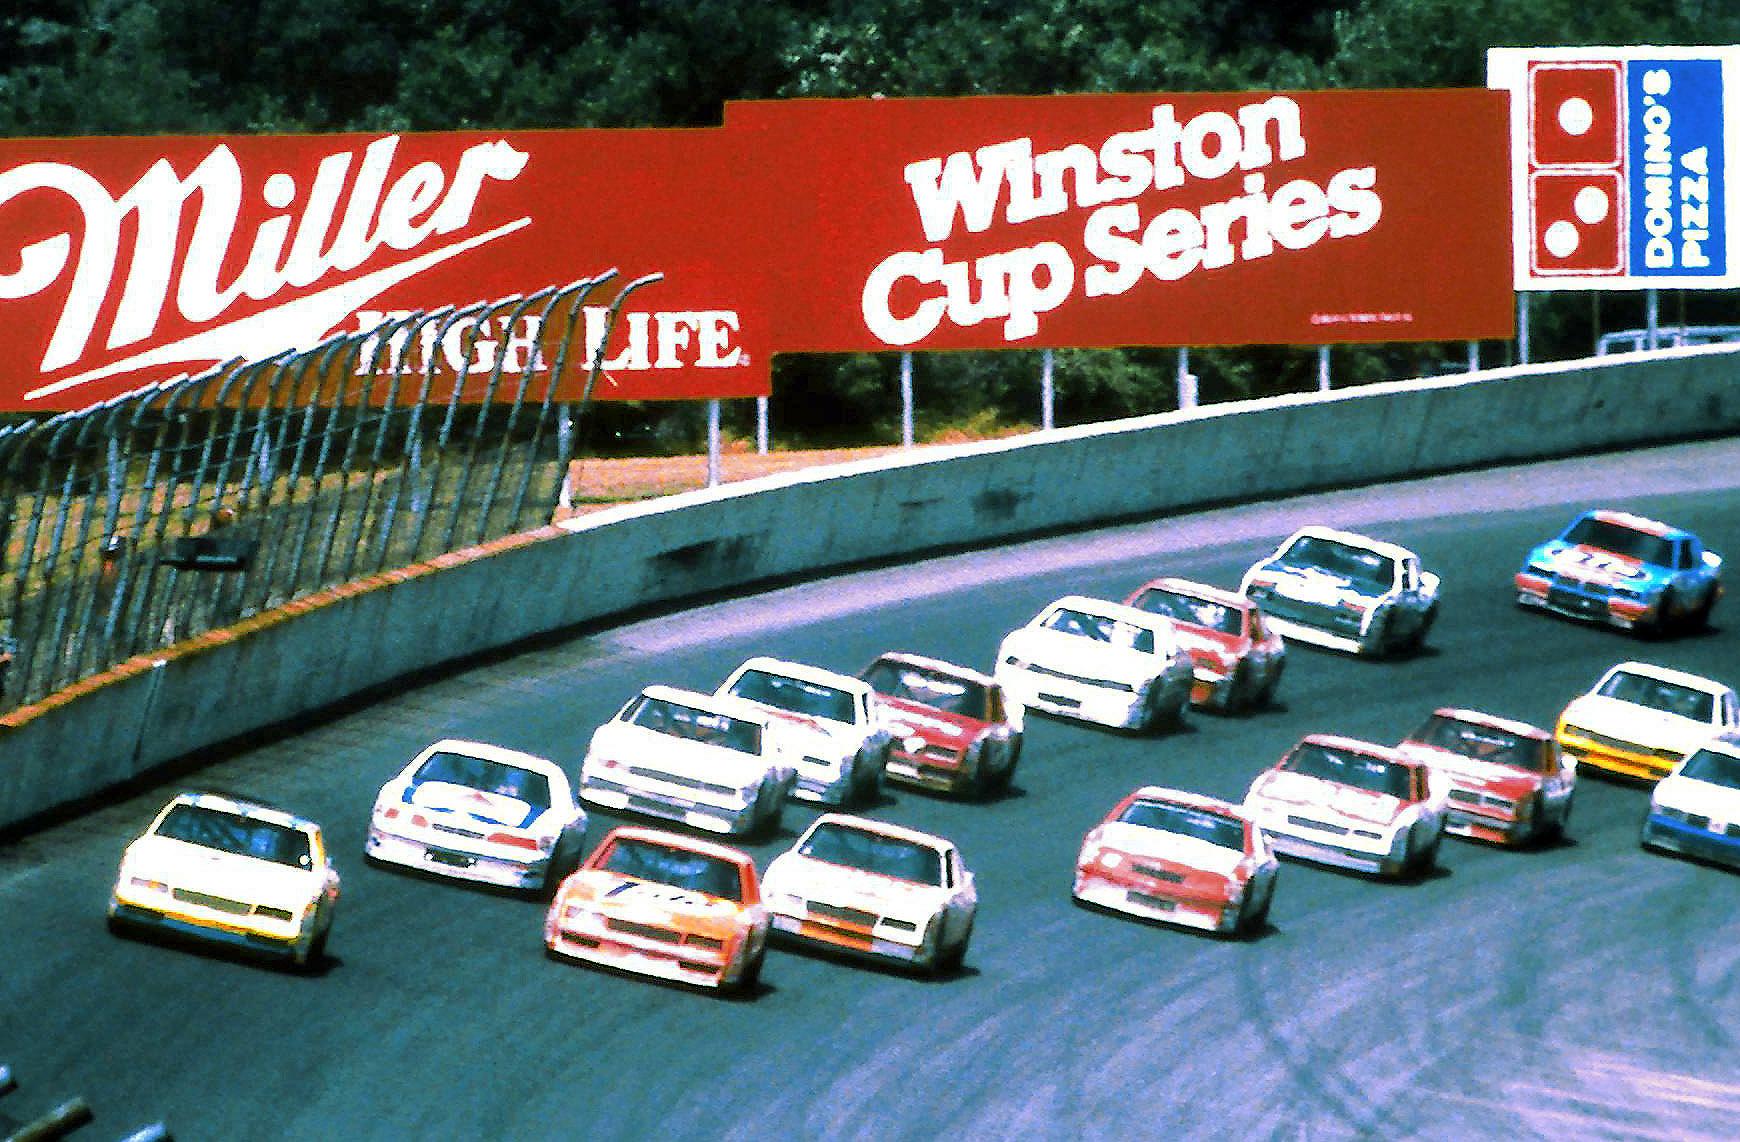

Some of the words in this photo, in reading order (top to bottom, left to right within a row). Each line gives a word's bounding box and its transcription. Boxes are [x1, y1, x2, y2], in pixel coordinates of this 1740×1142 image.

[0, 135, 529, 372] Miller
[862, 242, 1075, 345] Cup
[1083, 167, 1382, 298] Series
[1642, 69, 1674, 268] DOMINO'S
[1680, 146, 1710, 268] PIZZA
[355, 309, 548, 376] HIGH
[581, 306, 743, 372] LIFE
